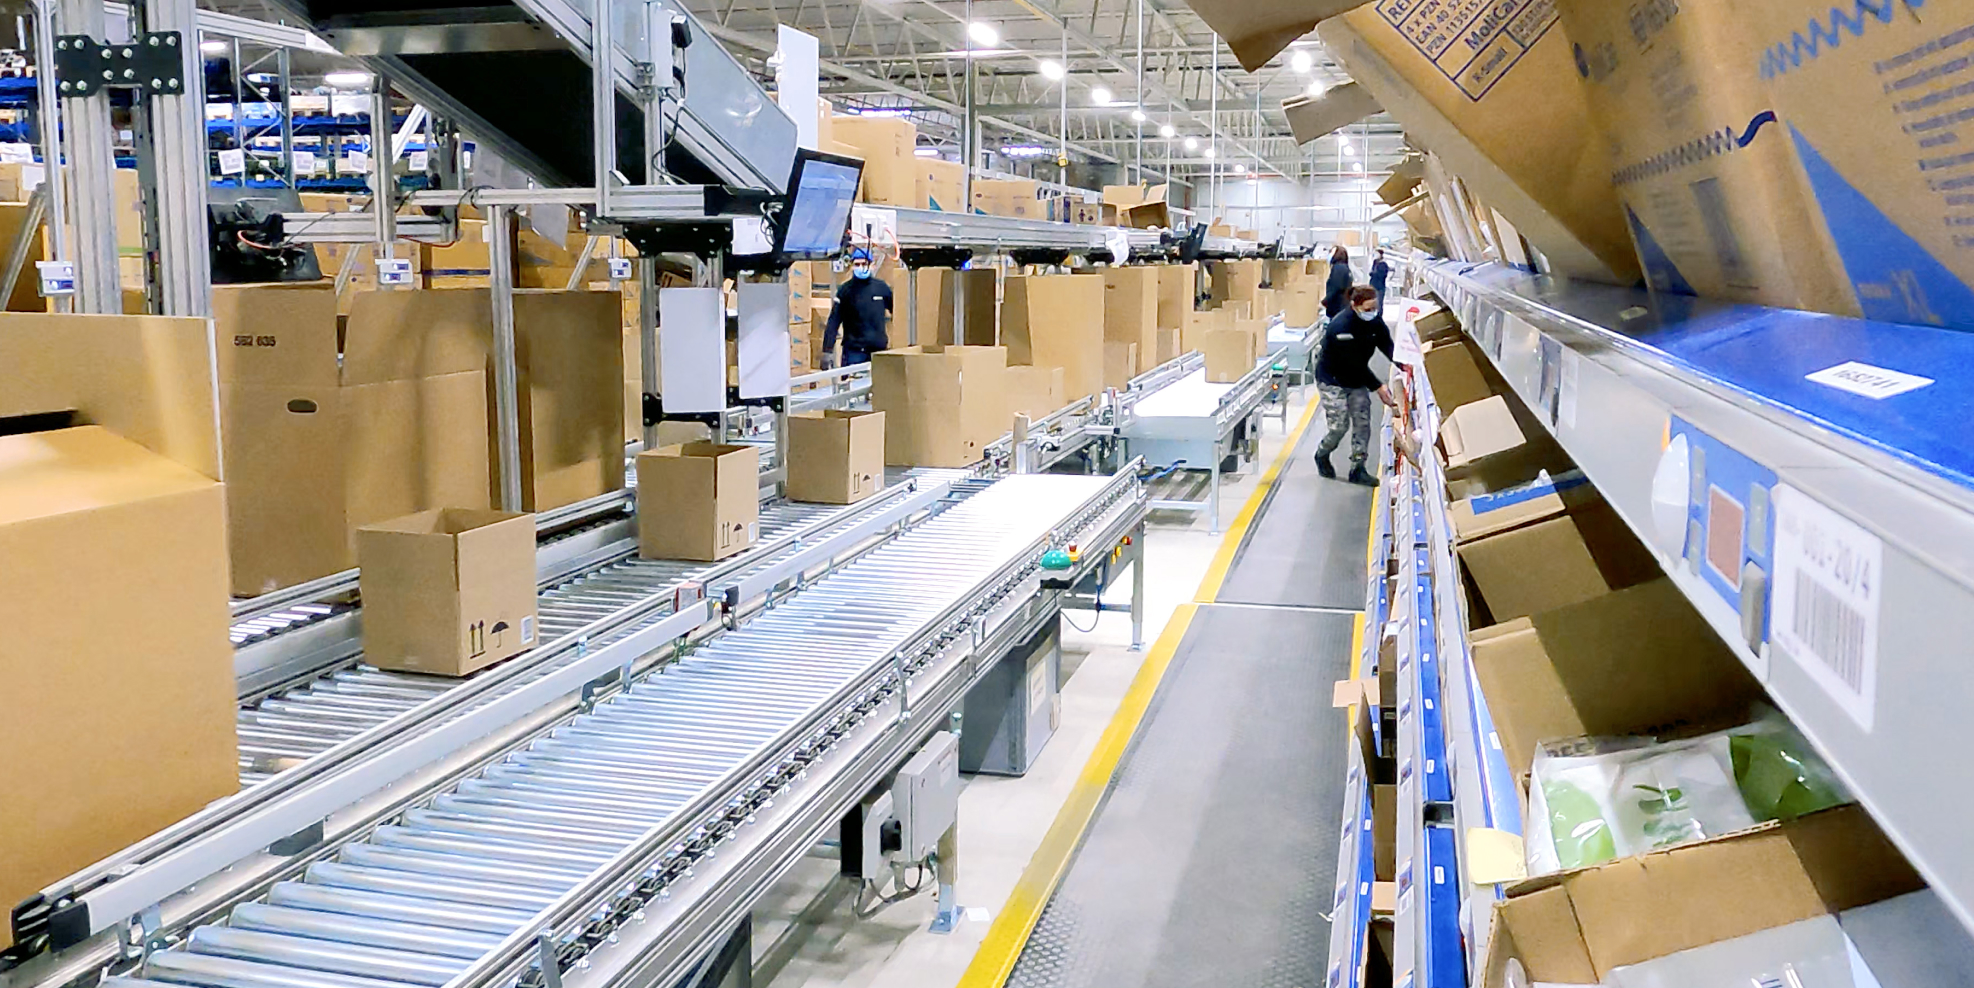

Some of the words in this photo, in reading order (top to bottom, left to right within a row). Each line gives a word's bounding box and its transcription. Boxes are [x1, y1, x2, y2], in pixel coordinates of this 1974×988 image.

[1406, 25, 1414, 34] 4
[1413, 18, 1422, 27] x
[1420, 0, 1440, 19] PZN
[1416, 22, 1437, 44] EAN
[1436, 9, 1450, 23] 40
[1426, 33, 1447, 54] PZN
